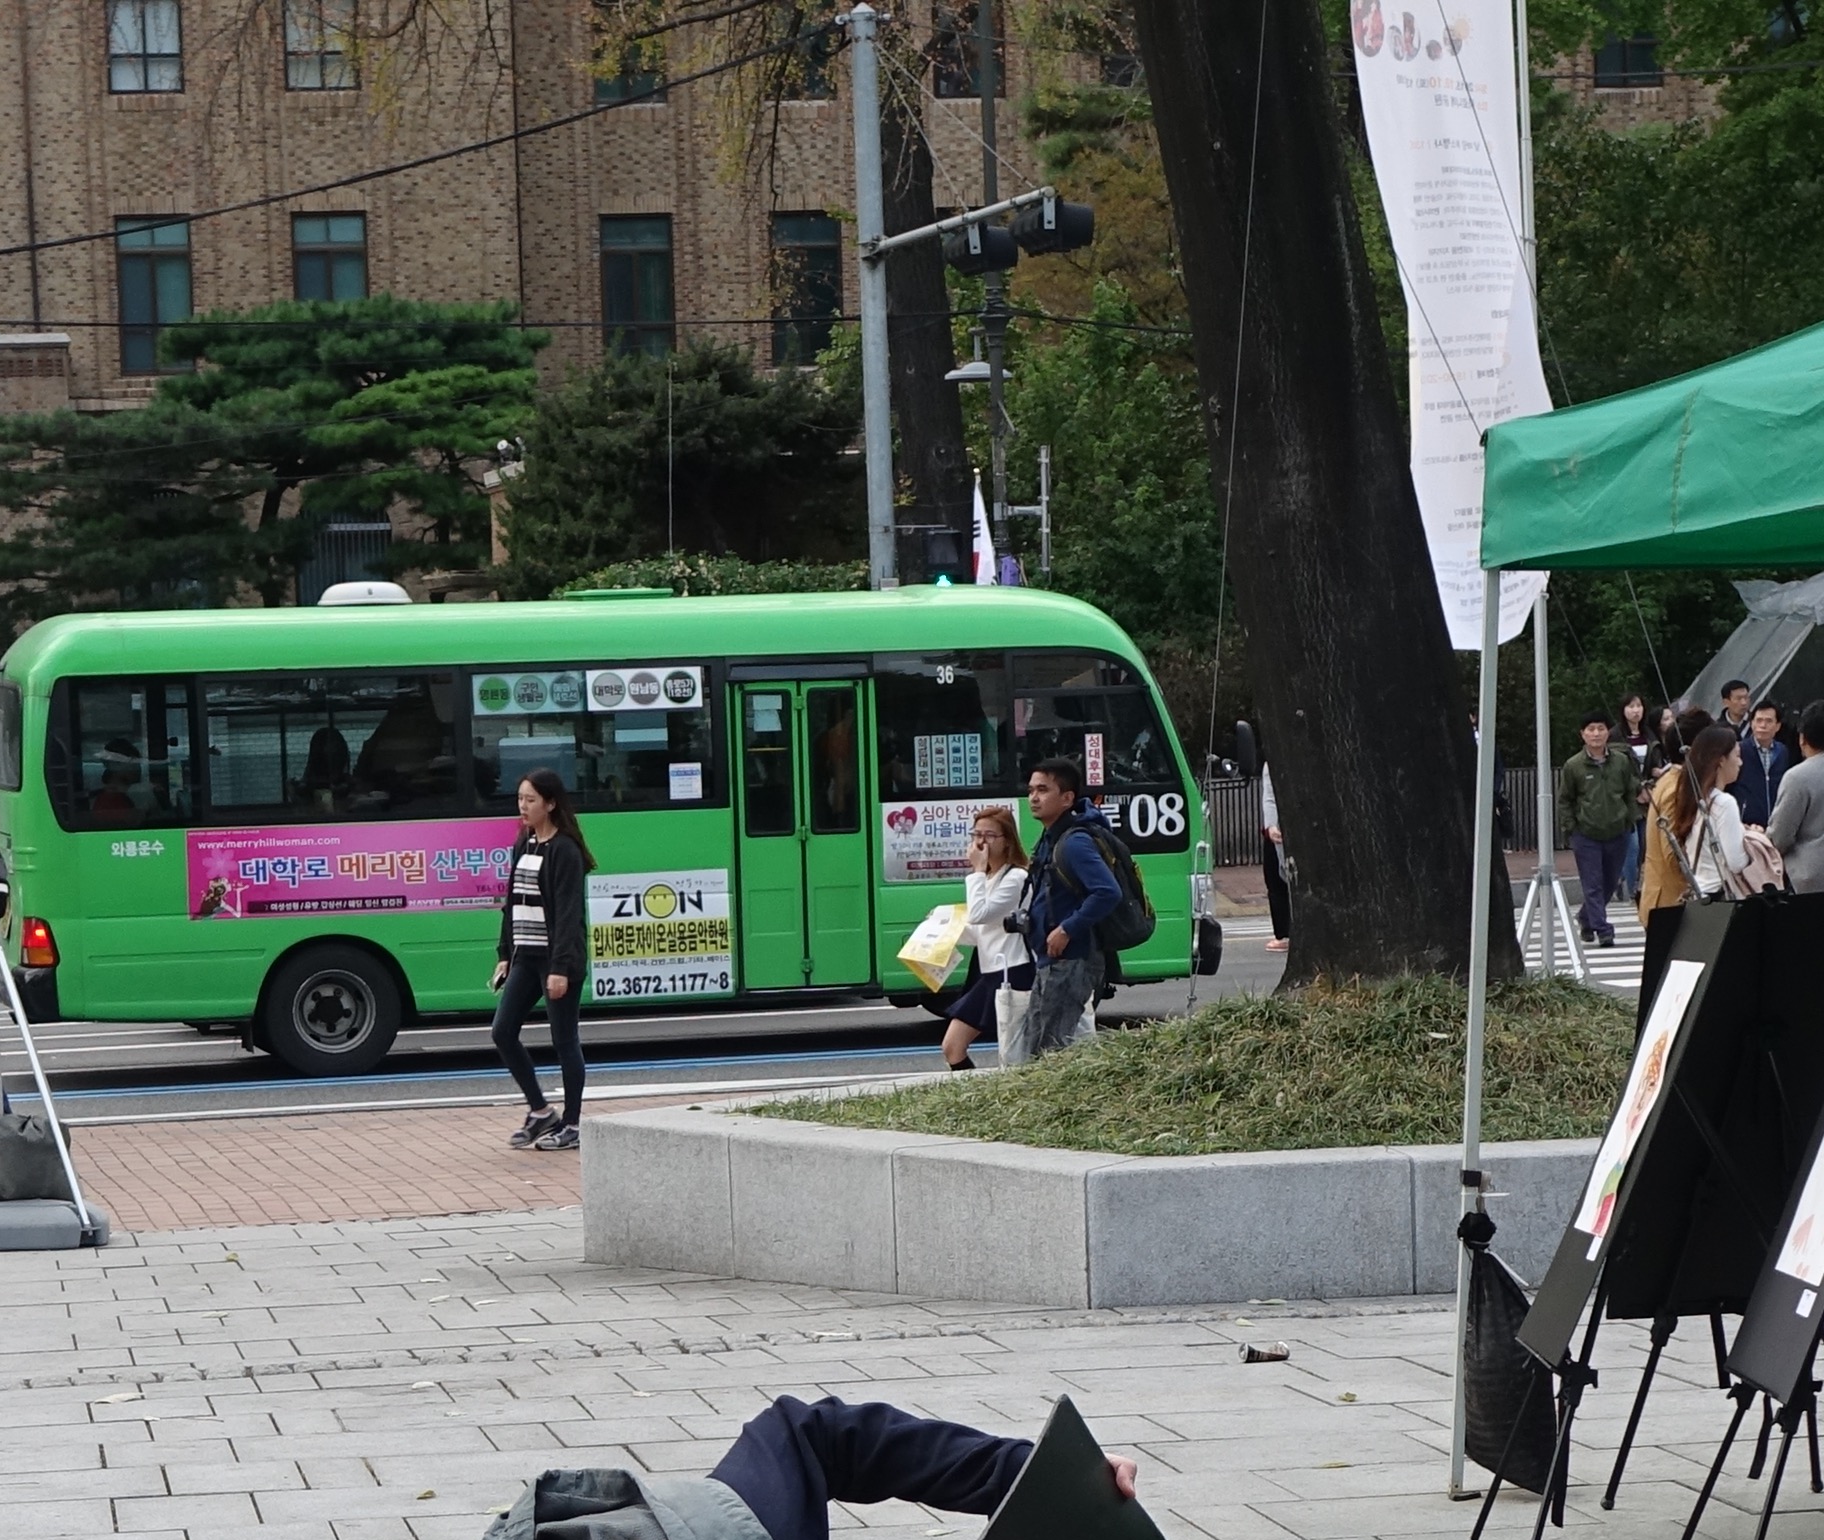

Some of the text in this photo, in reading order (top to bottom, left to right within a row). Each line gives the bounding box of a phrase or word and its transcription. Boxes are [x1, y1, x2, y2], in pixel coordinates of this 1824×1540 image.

[936, 665, 954, 684] 36
[593, 684, 624, 698] 대학로
[1087, 735, 1101, 785] 성대후문
[921, 804, 951, 822] 심야
[1129, 793, 1185, 837] 08
[197, 836, 341, 851] www.merryhillwoman.com
[238, 854, 334, 888] 대학로
[338, 850, 428, 885] 메리힐
[593, 919, 729, 957] 입시명문자이온실용음악학원
[596, 972, 729, 996] 02.3672.1177~8
